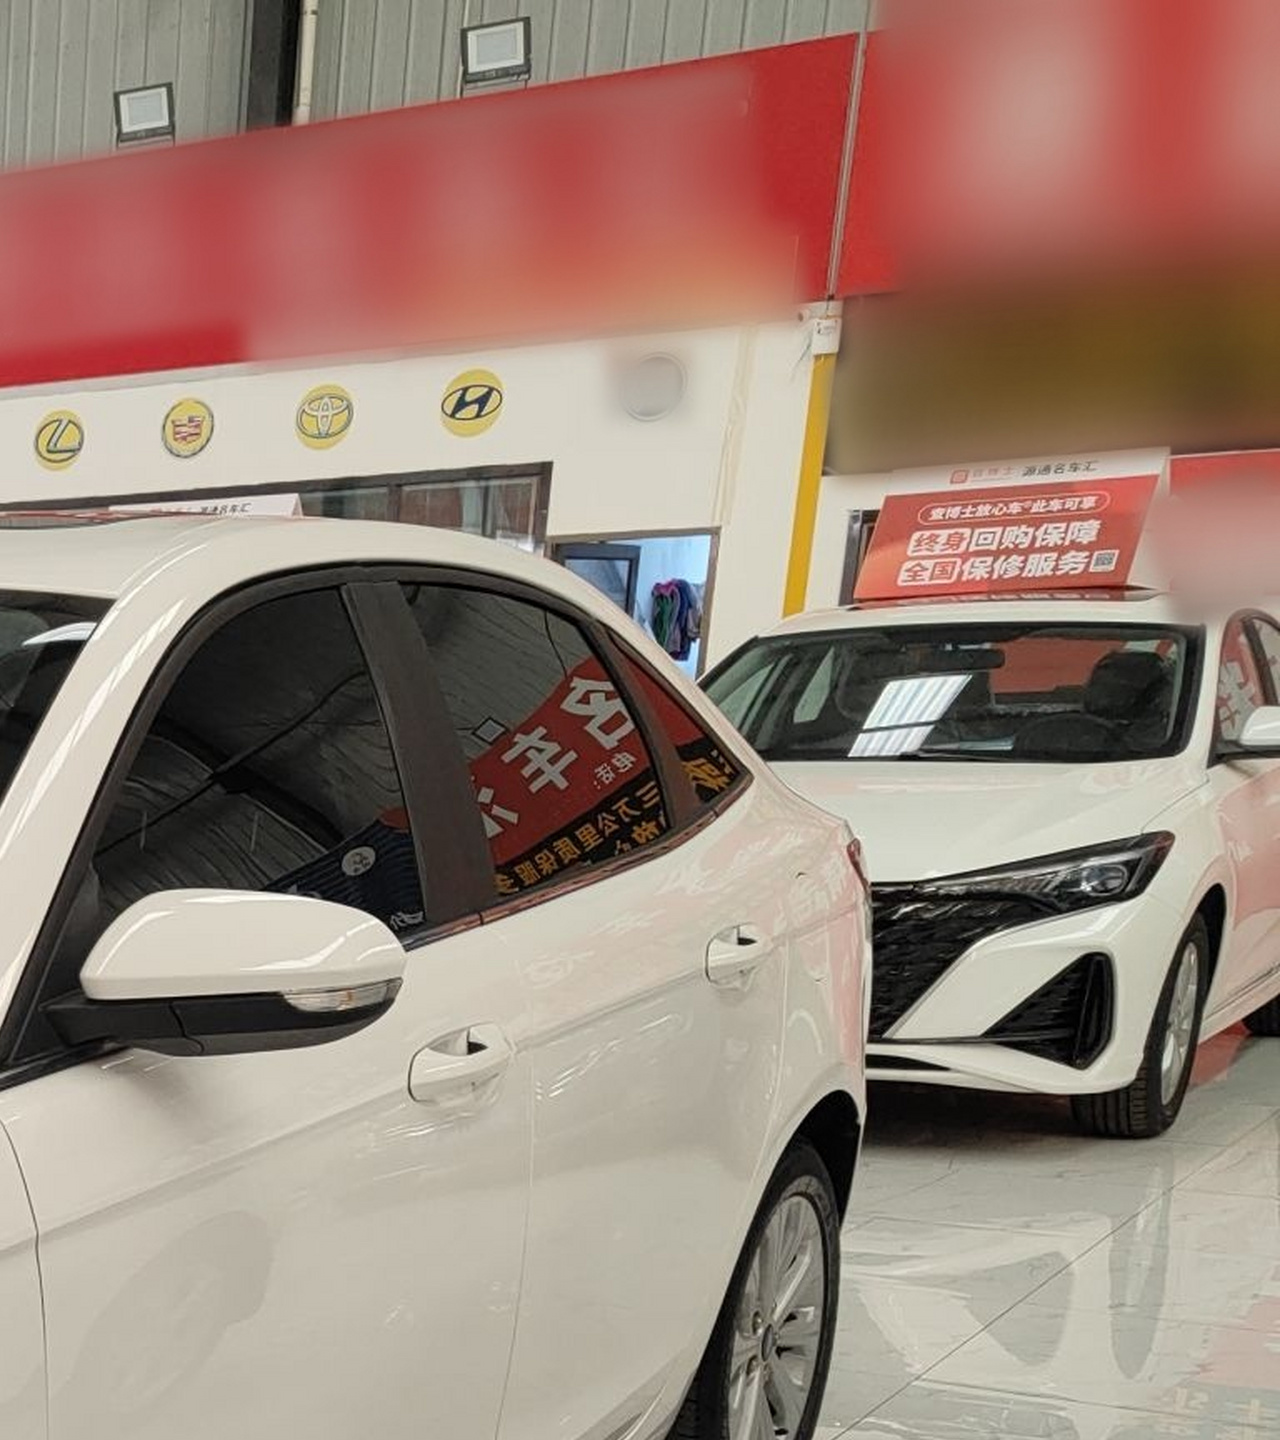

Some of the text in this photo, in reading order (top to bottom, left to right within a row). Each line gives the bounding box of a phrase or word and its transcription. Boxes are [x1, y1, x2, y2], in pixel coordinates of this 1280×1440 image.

[1021, 460, 1099, 478] 源通名车汇
[910, 519, 1101, 556] 终身回购保障
[898, 551, 1091, 586] 全国保修服务
